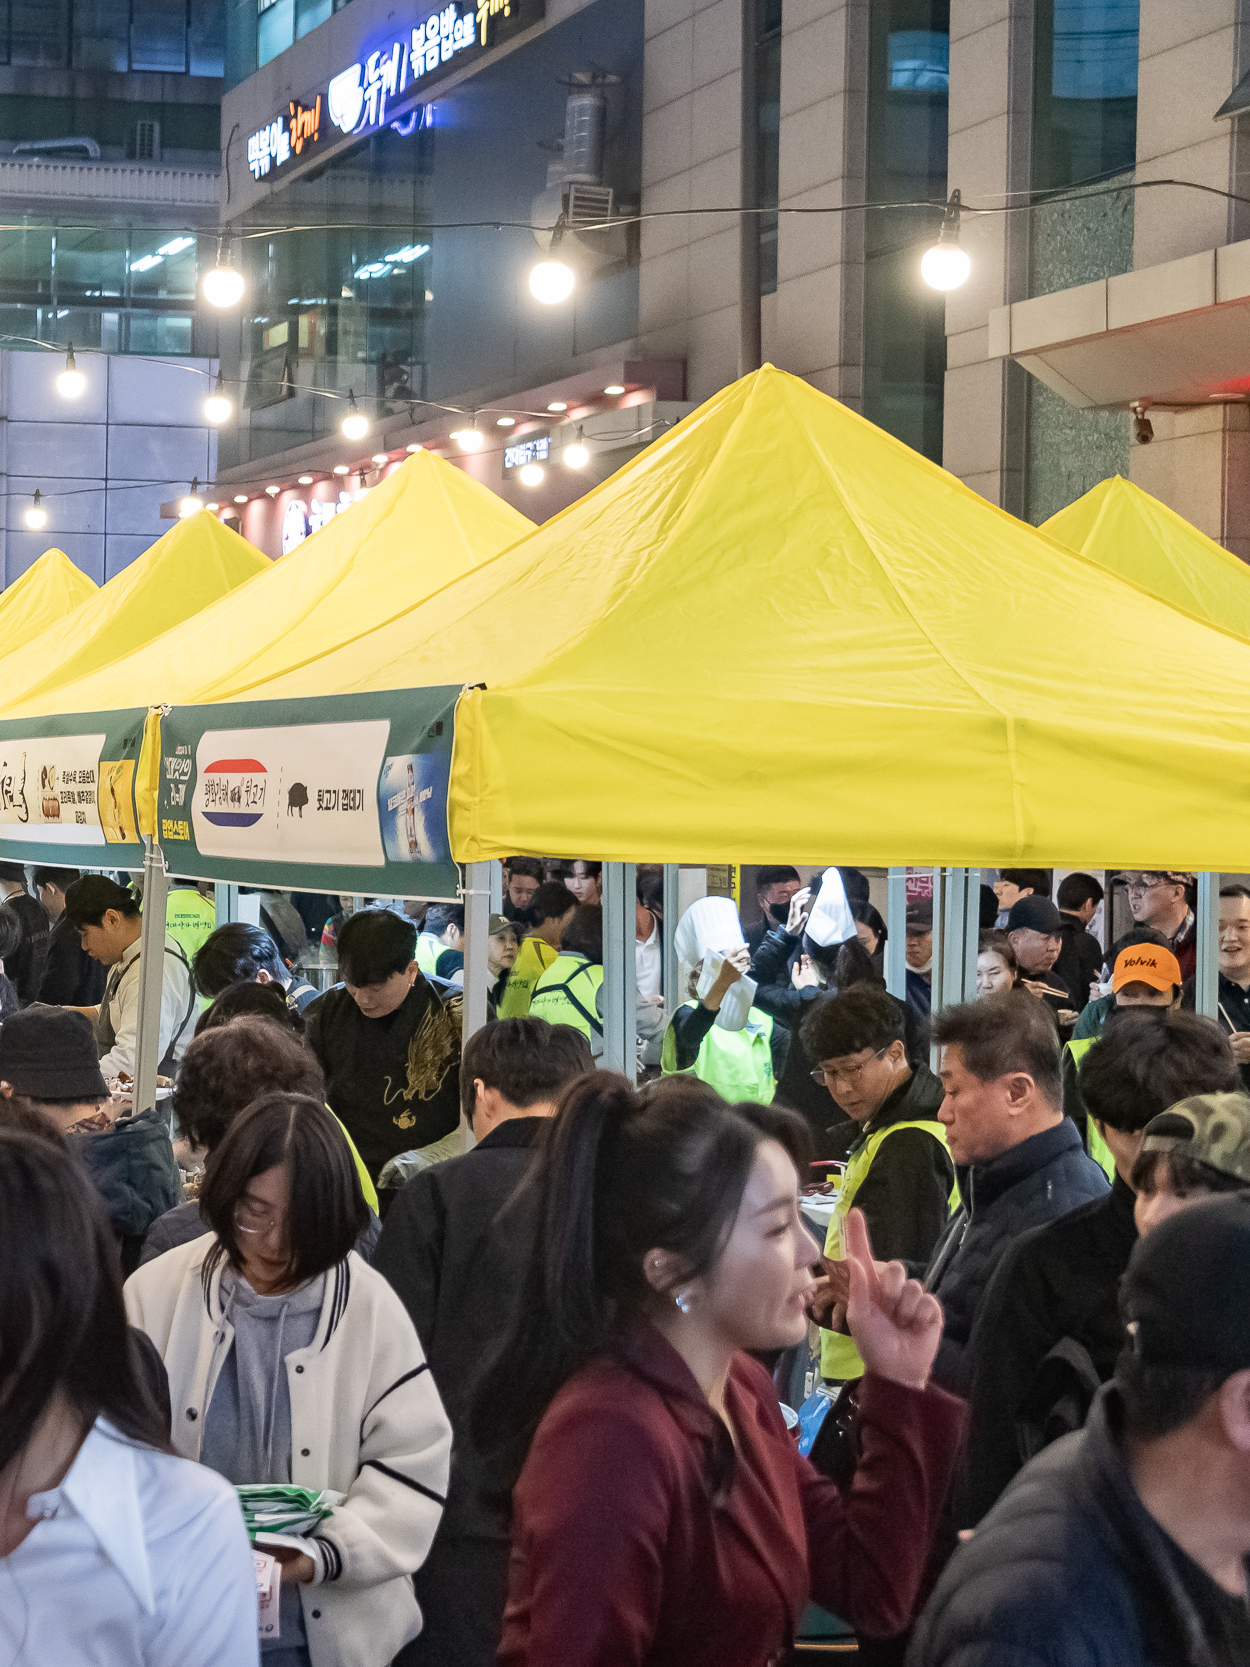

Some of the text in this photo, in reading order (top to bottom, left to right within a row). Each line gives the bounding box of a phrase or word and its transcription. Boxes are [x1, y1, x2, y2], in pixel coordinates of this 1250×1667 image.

[410, 3, 476, 79] 볶음밥으로
[317, 789, 339, 811] 뒷고기
[341, 789, 364, 811] 껍데기
[1124, 956, 1158, 969] Volvik
